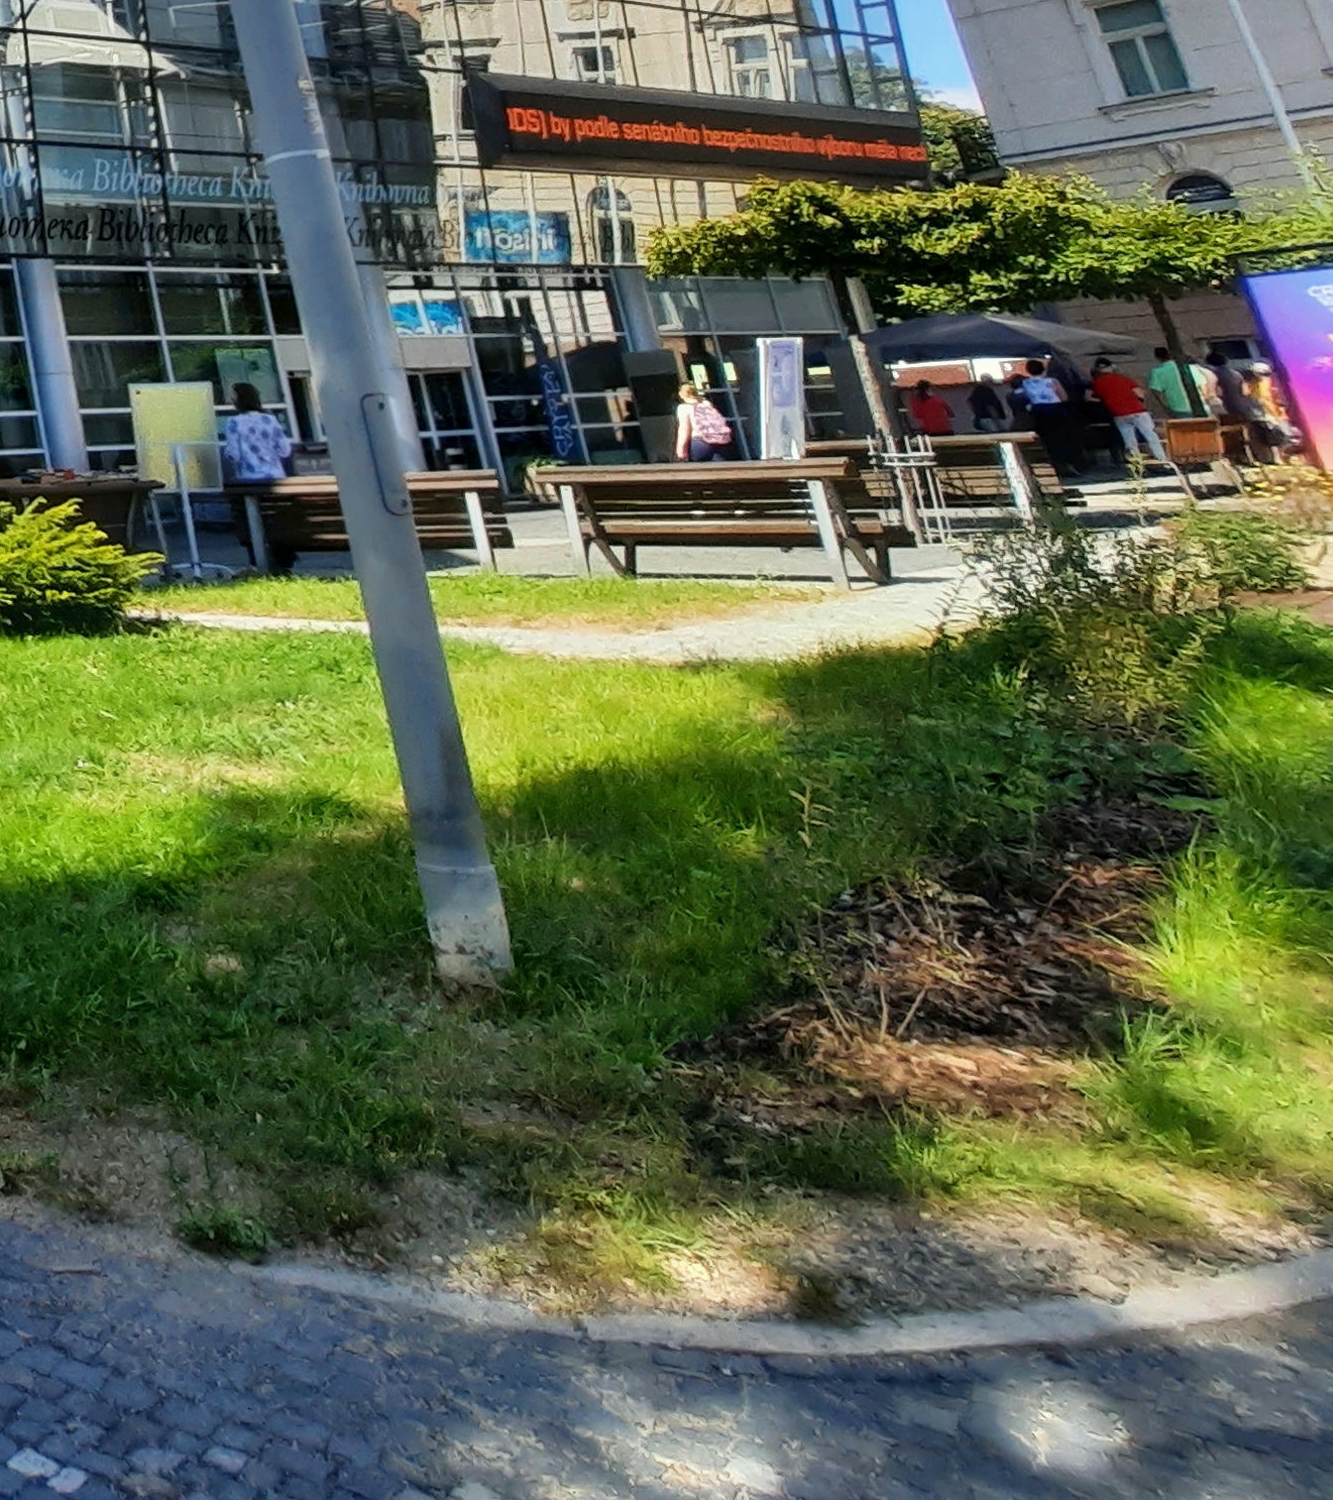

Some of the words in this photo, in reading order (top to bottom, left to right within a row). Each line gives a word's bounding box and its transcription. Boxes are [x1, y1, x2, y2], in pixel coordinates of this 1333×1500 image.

[549, 111, 571, 142] by
[575, 115, 620, 142] podle
[92, 157, 225, 198] Bibliotheca
